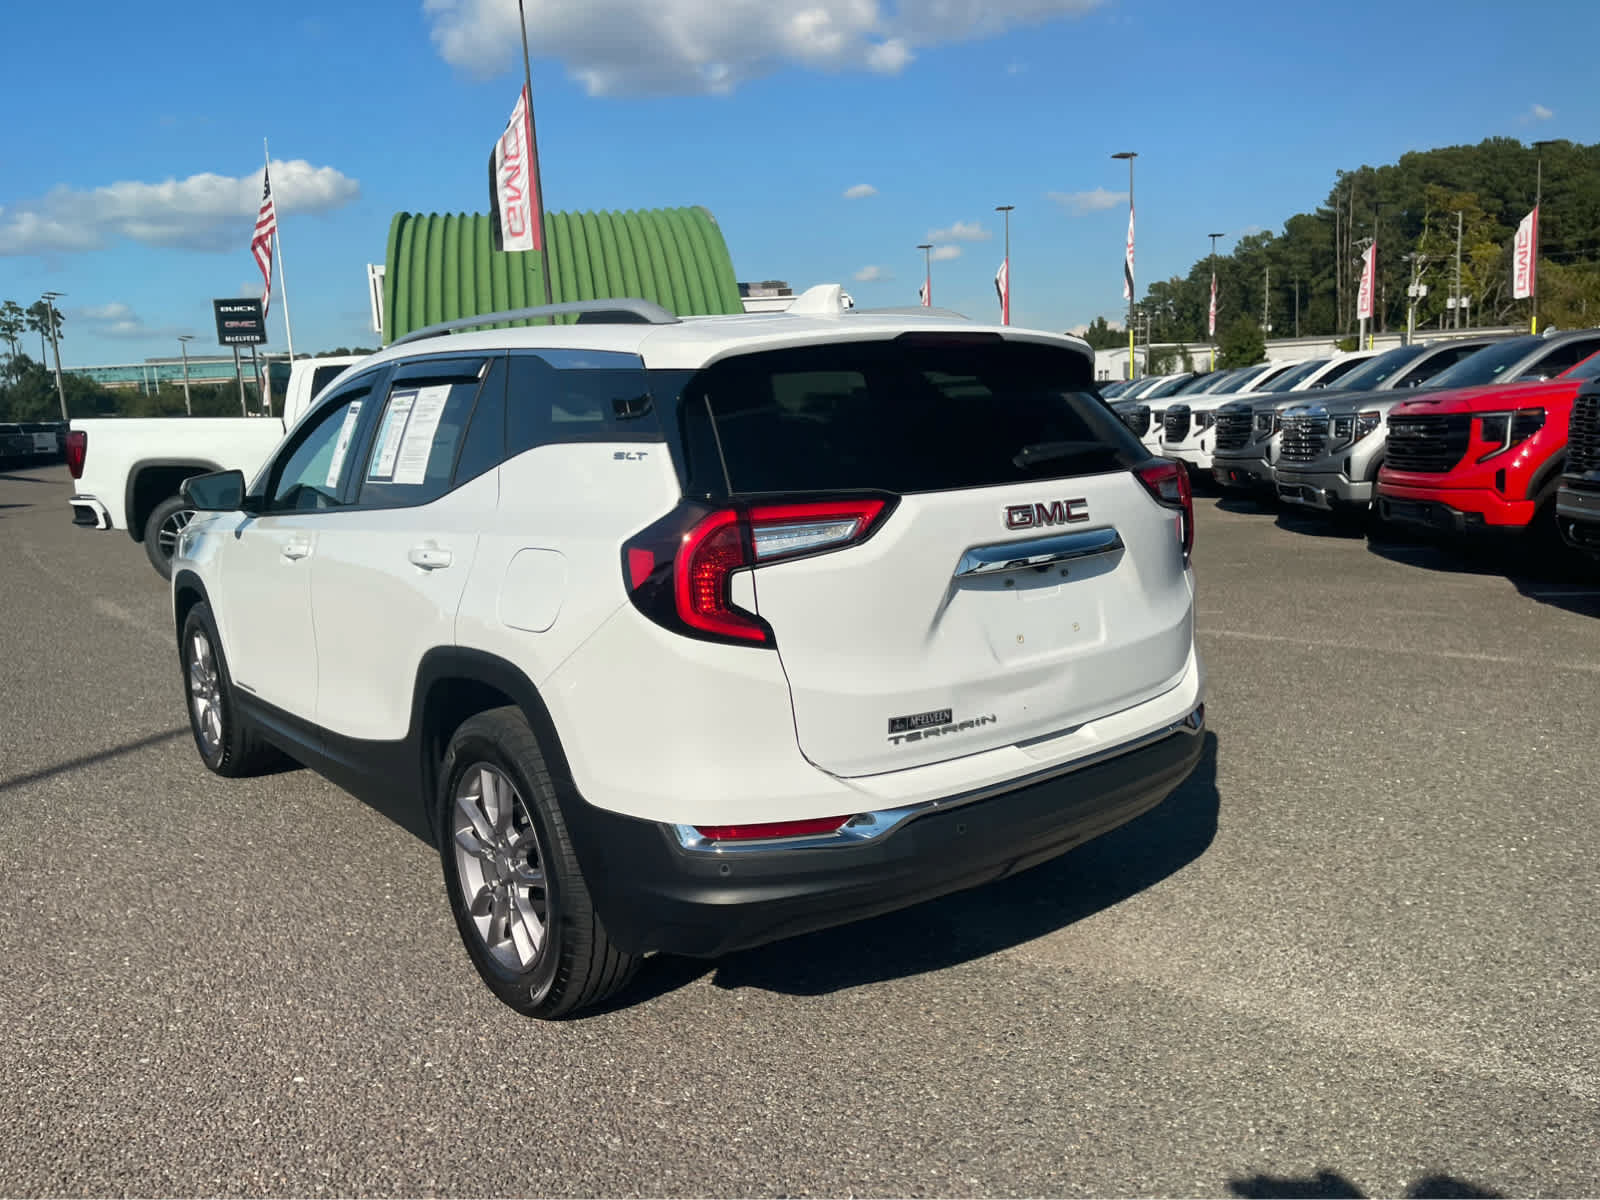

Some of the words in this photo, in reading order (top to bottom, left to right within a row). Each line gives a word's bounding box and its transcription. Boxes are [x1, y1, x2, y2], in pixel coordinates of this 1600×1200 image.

[224, 320, 257, 328] GMC
[613, 452, 649, 461] SLT
[1005, 497, 1090, 531] GMC
[888, 714, 997, 745] TERRAIN
